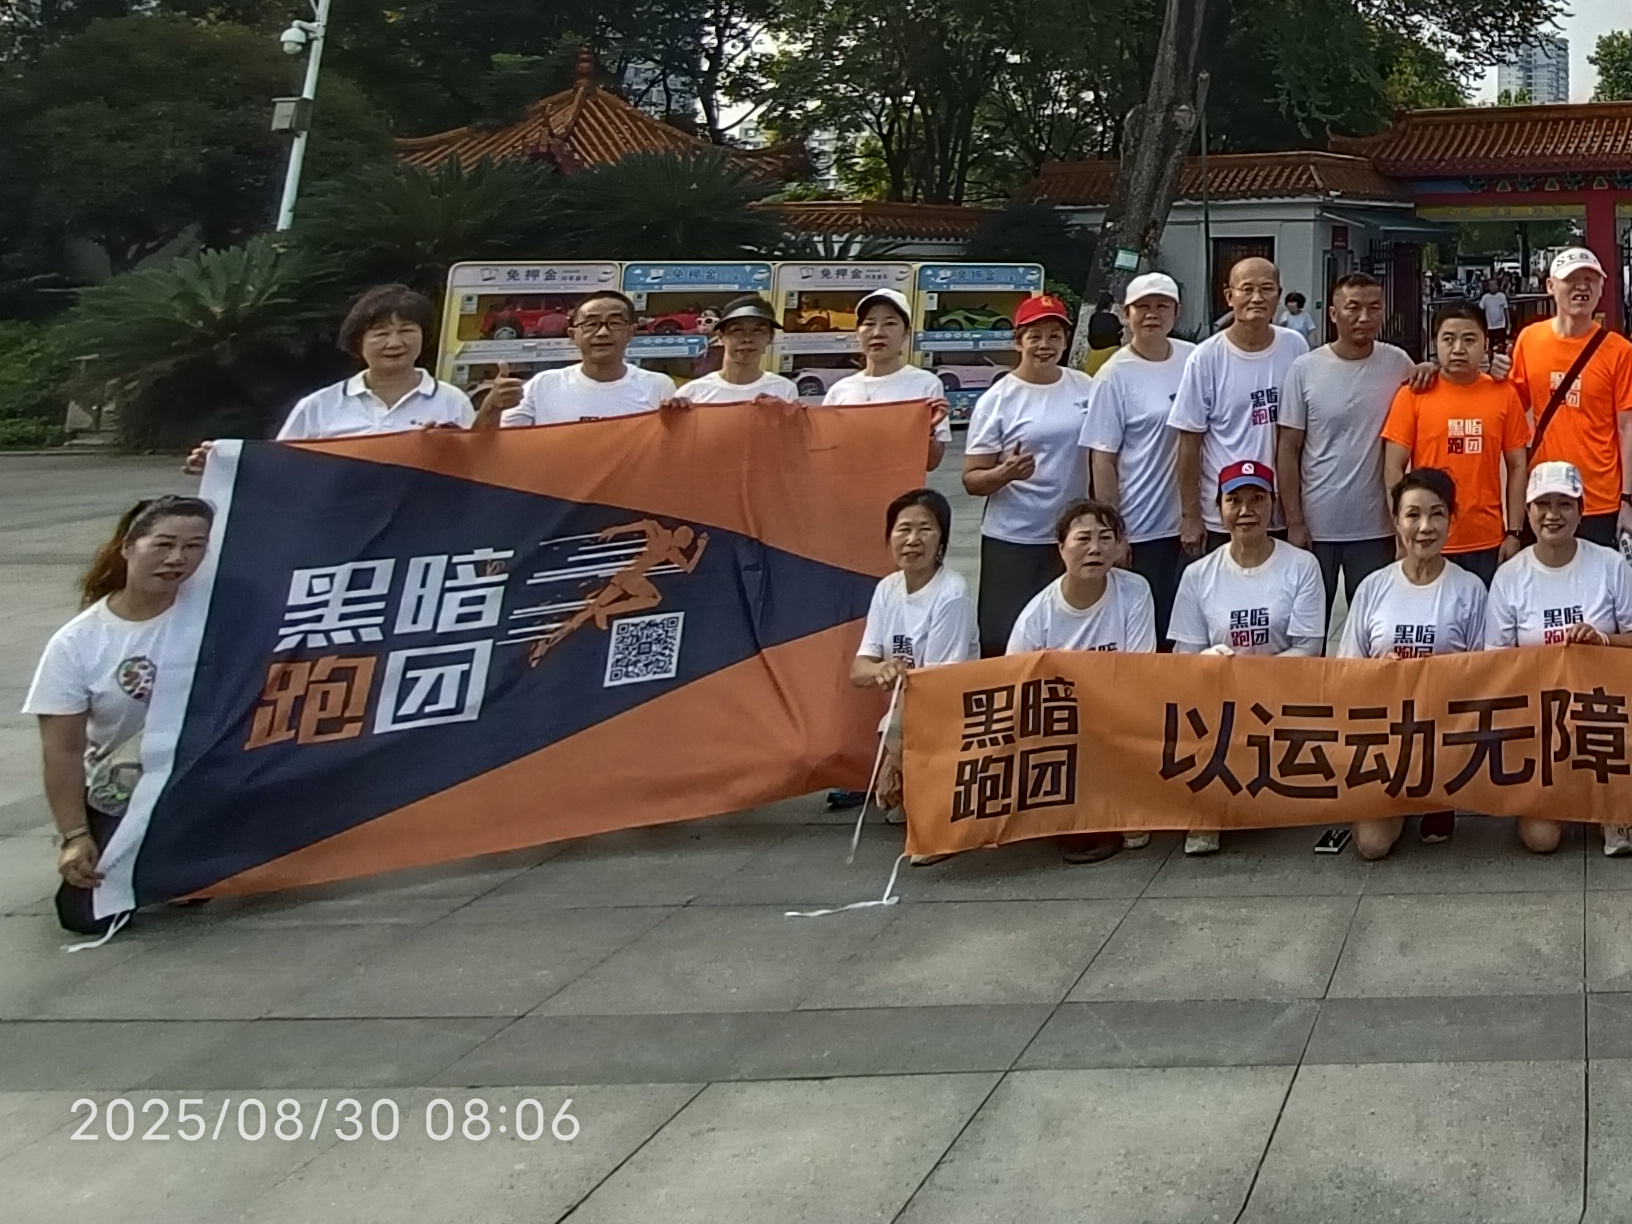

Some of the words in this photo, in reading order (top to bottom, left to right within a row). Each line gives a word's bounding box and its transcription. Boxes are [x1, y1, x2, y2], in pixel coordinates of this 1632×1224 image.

[506, 268, 558, 282] 免押金
[820, 268, 863, 280] 免押金
[1447, 418, 1482, 436] 黑暗
[273, 547, 515, 653] 黑暗
[1230, 607, 1270, 630] 黑暗
[1544, 605, 1584, 629] 黑暗
[1230, 628, 1270, 648] 跑团
[1394, 624, 1437, 645] 黑暗
[244, 638, 495, 751] 跑团
[960, 676, 1079, 753] 黑暗
[951, 744, 1077, 823] 跑团
